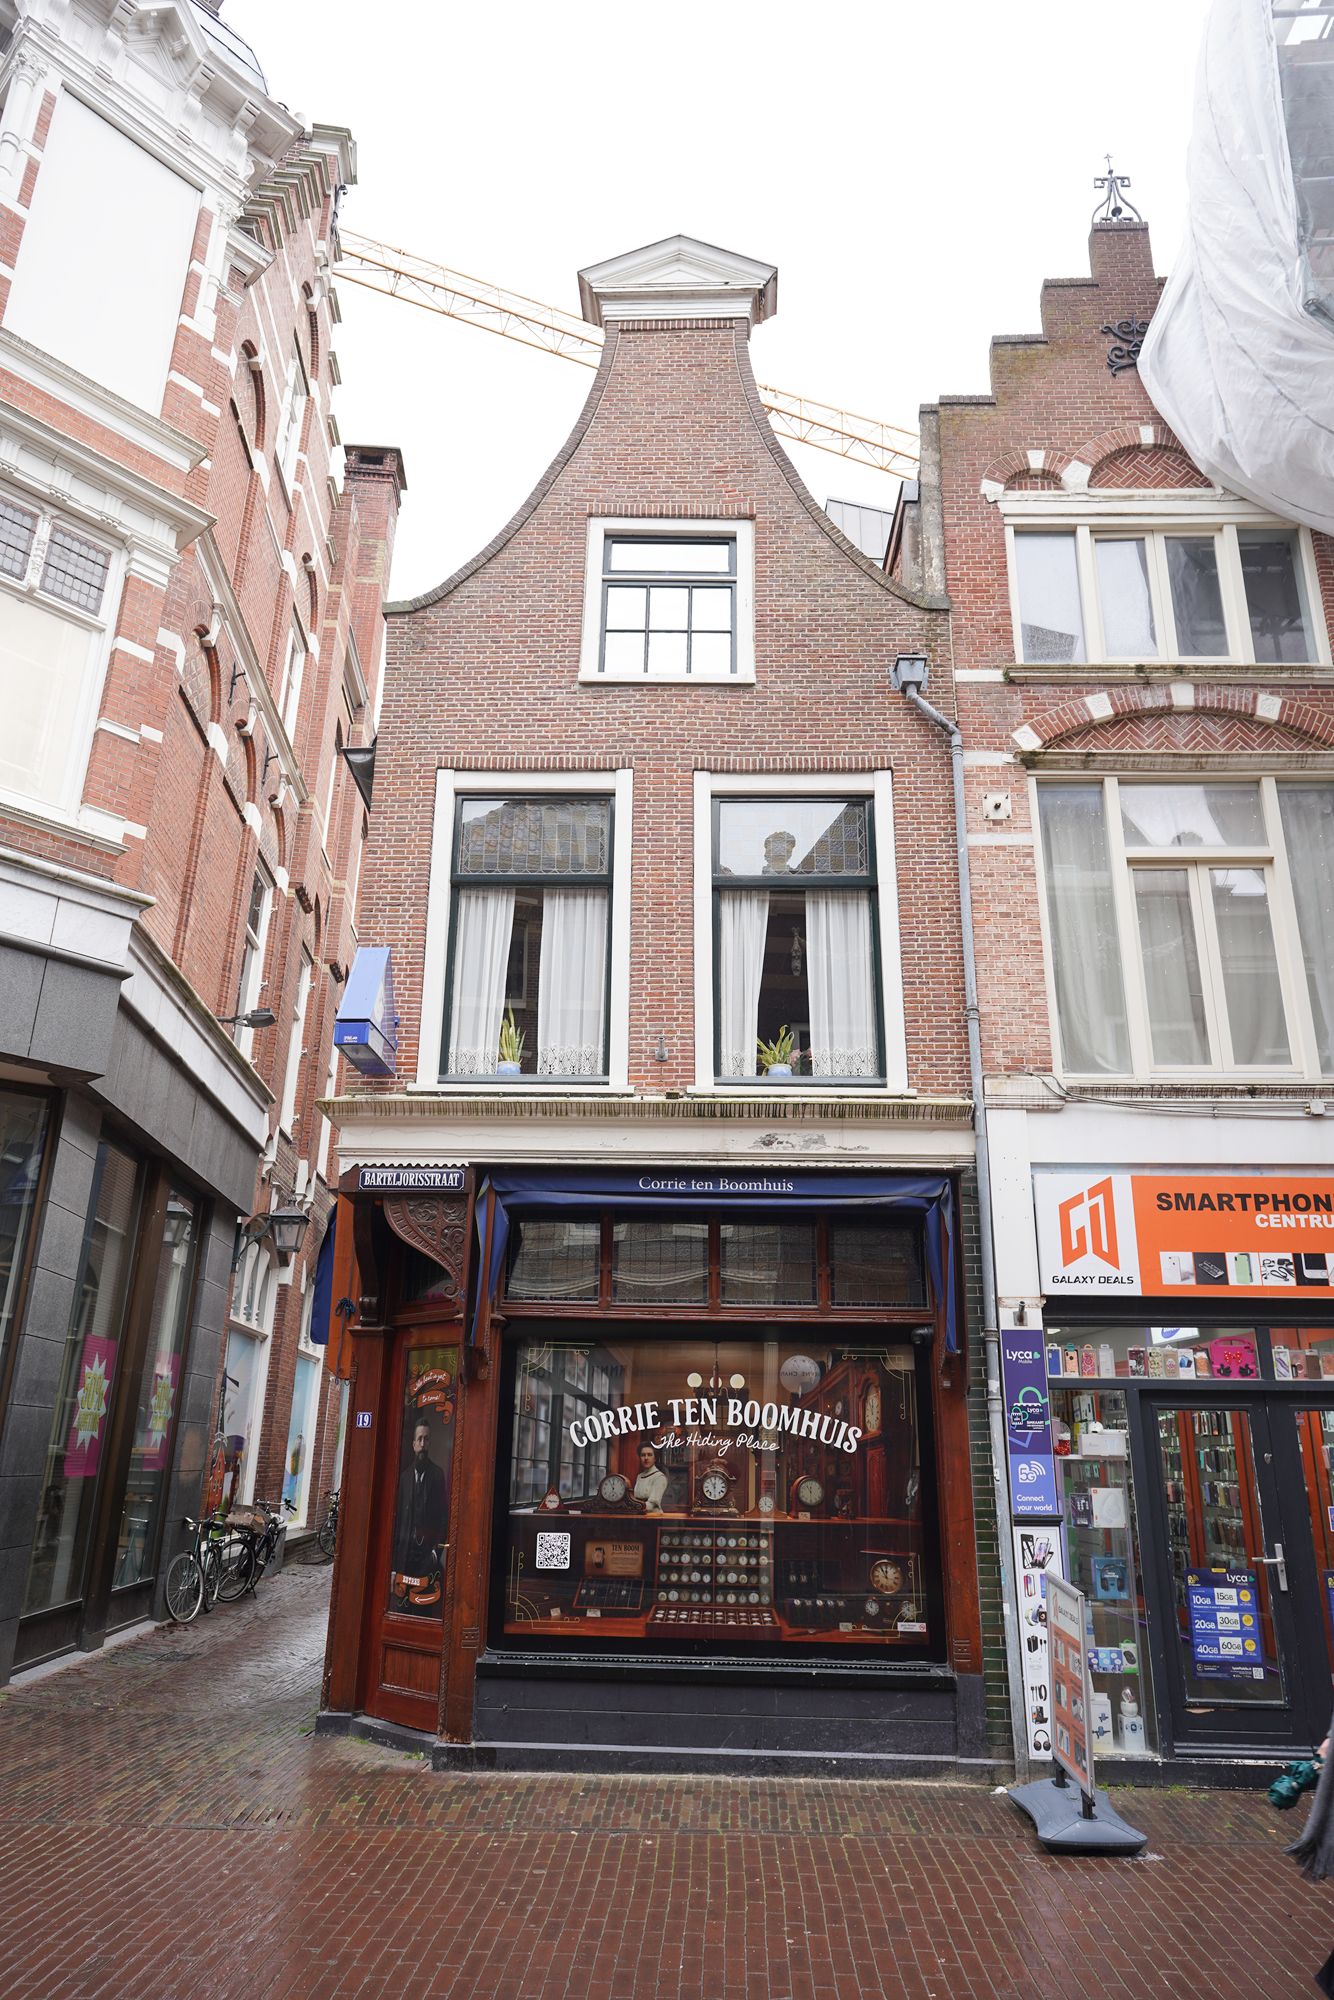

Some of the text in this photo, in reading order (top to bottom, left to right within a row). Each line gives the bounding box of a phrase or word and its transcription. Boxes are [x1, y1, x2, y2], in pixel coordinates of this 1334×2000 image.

[364, 1172, 460, 1187] BARTELJORISSTRAAT
[638, 1176, 794, 1192] Corrie ten Boomhuis
[1156, 1193, 1334, 1212] SMARTPHON
[1052, 1275, 1134, 1285] GALAXY DEALS
[1006, 1349, 1033, 1361] Lyca
[359, 1414, 369, 1427] 19
[569, 1398, 863, 1454] CORRIE TEN BOOMHUIS
[651, 1431, 780, 1457] The Hiding Place
[1016, 1494, 1045, 1502] Connect
[612, 1544, 640, 1552] TEN BOOM
[1226, 1573, 1248, 1583] Lyca
[1192, 1595, 1211, 1605] 10GB
[1216, 1592, 1234, 1601] 15GB
[1195, 1619, 1216, 1629] 20GB
[1219, 1616, 1239, 1625] 30GB
[1197, 1645, 1219, 1654] 40GB
[1221, 1641, 1242, 1650] 60GB
